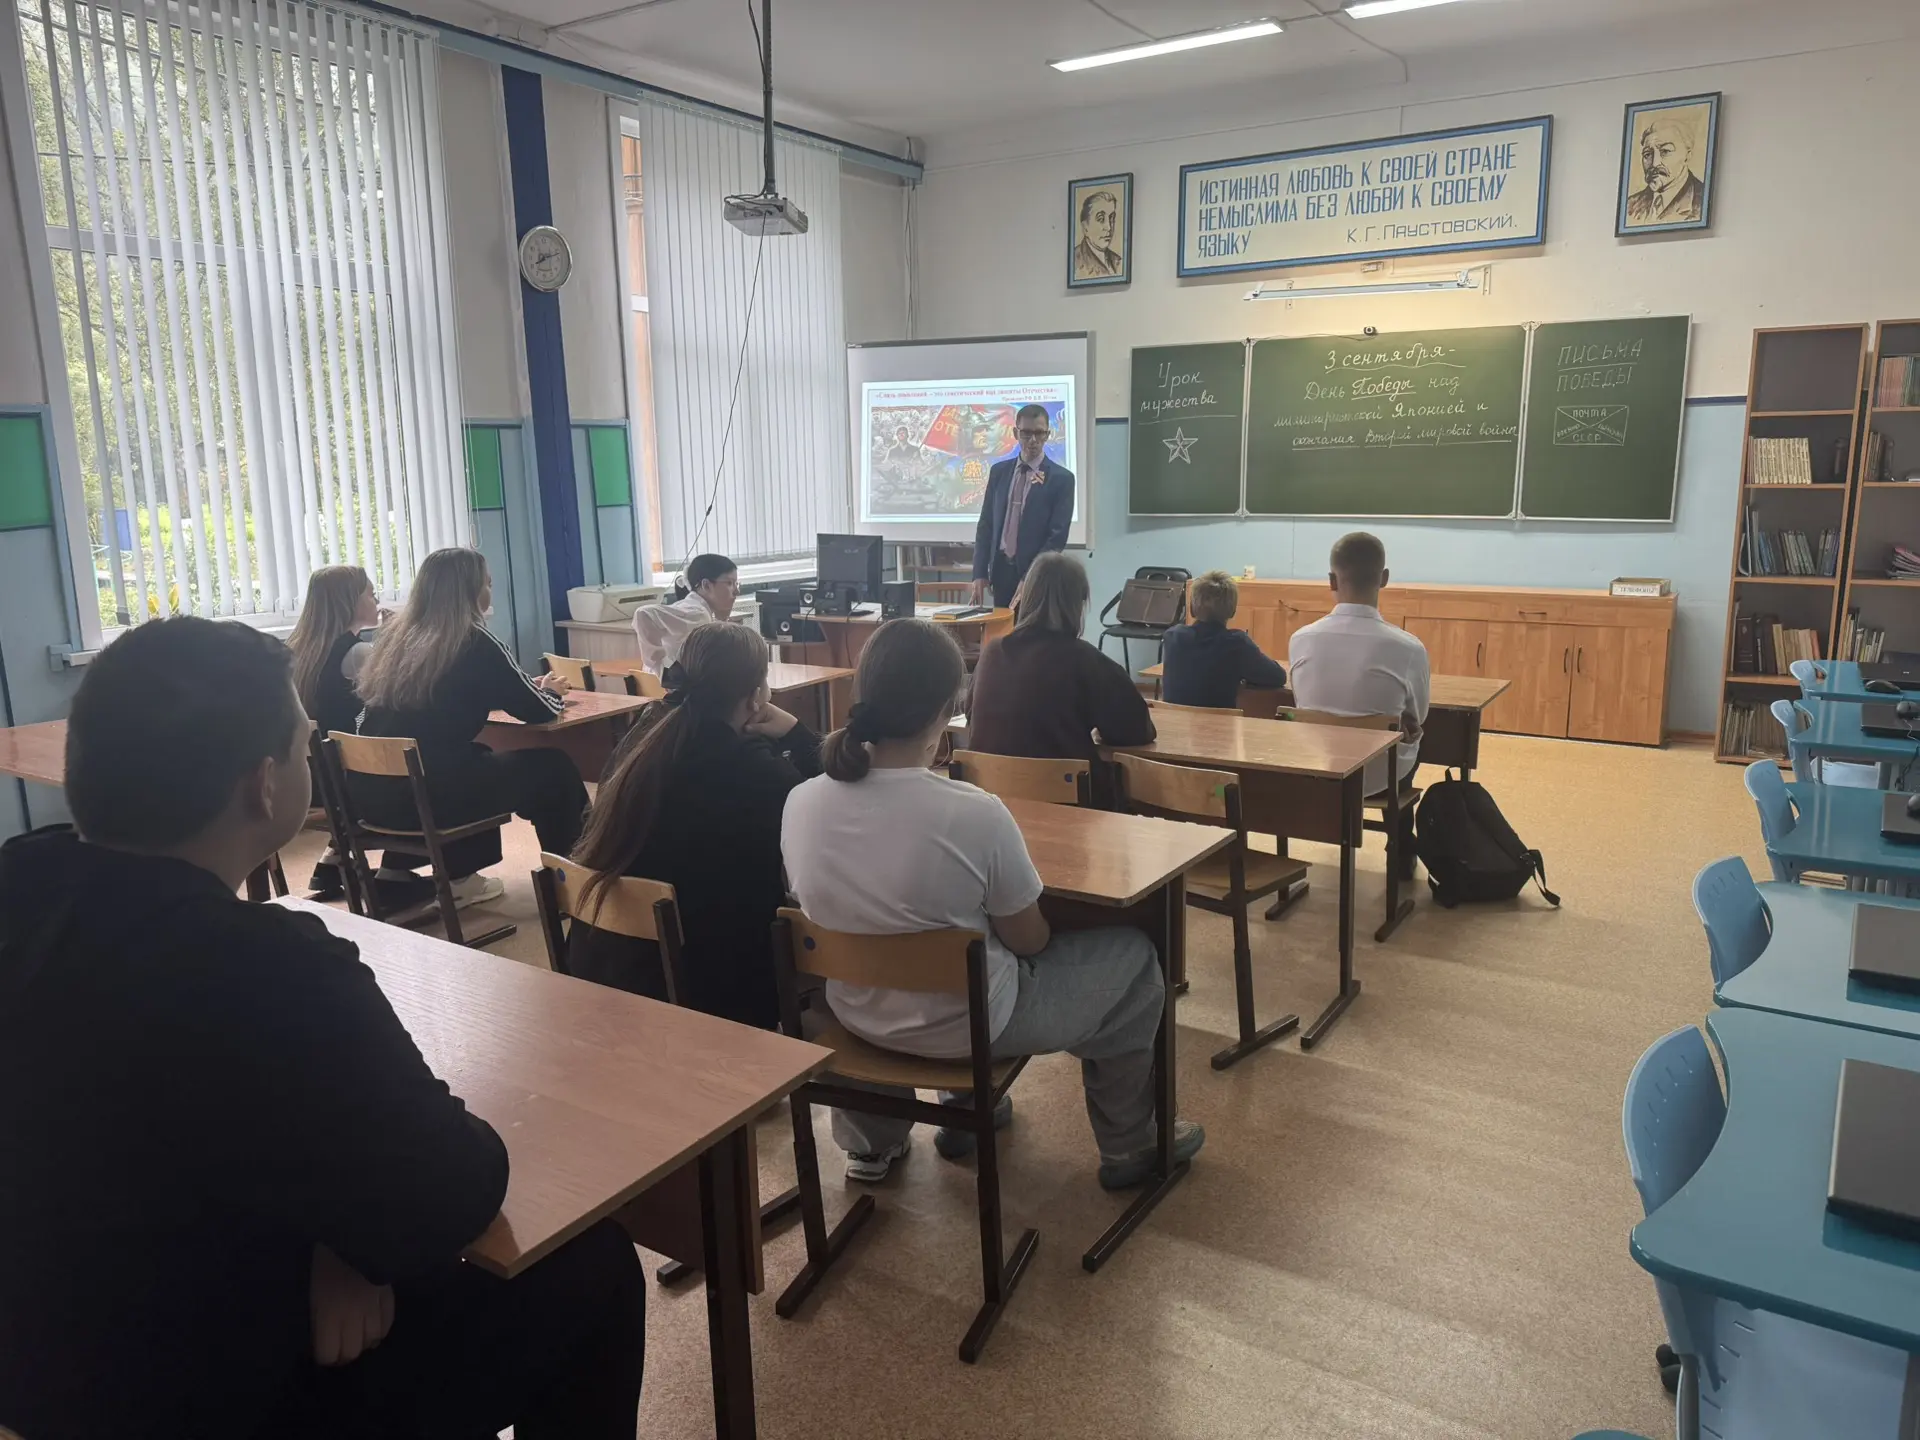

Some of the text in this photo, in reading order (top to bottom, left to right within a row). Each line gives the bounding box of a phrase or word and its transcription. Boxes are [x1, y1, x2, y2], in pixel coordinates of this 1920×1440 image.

[1199, 142, 1519, 206] ИСТИННАЯ ЛЮБОВЬ К СВОЕЙ СТРАНЕ
[1199, 173, 1508, 232] НЕМЫСЛИМА БЕЗ ЛЮБВИ К СВОЕМУ
[1198, 229, 1252, 259] ЯЗЫКУ
[1324, 350, 1337, 370] 3
[1557, 338, 1643, 366] ПИСЬМА
[1158, 361, 1205, 398] Урок
[1303, 375, 1461, 402] День Победы над
[1556, 366, 1633, 392] ПОБЕДЫ
[1140, 389, 1218, 419] мужества
[1391, 397, 1467, 419] Японией
[1477, 402, 1489, 411] и
